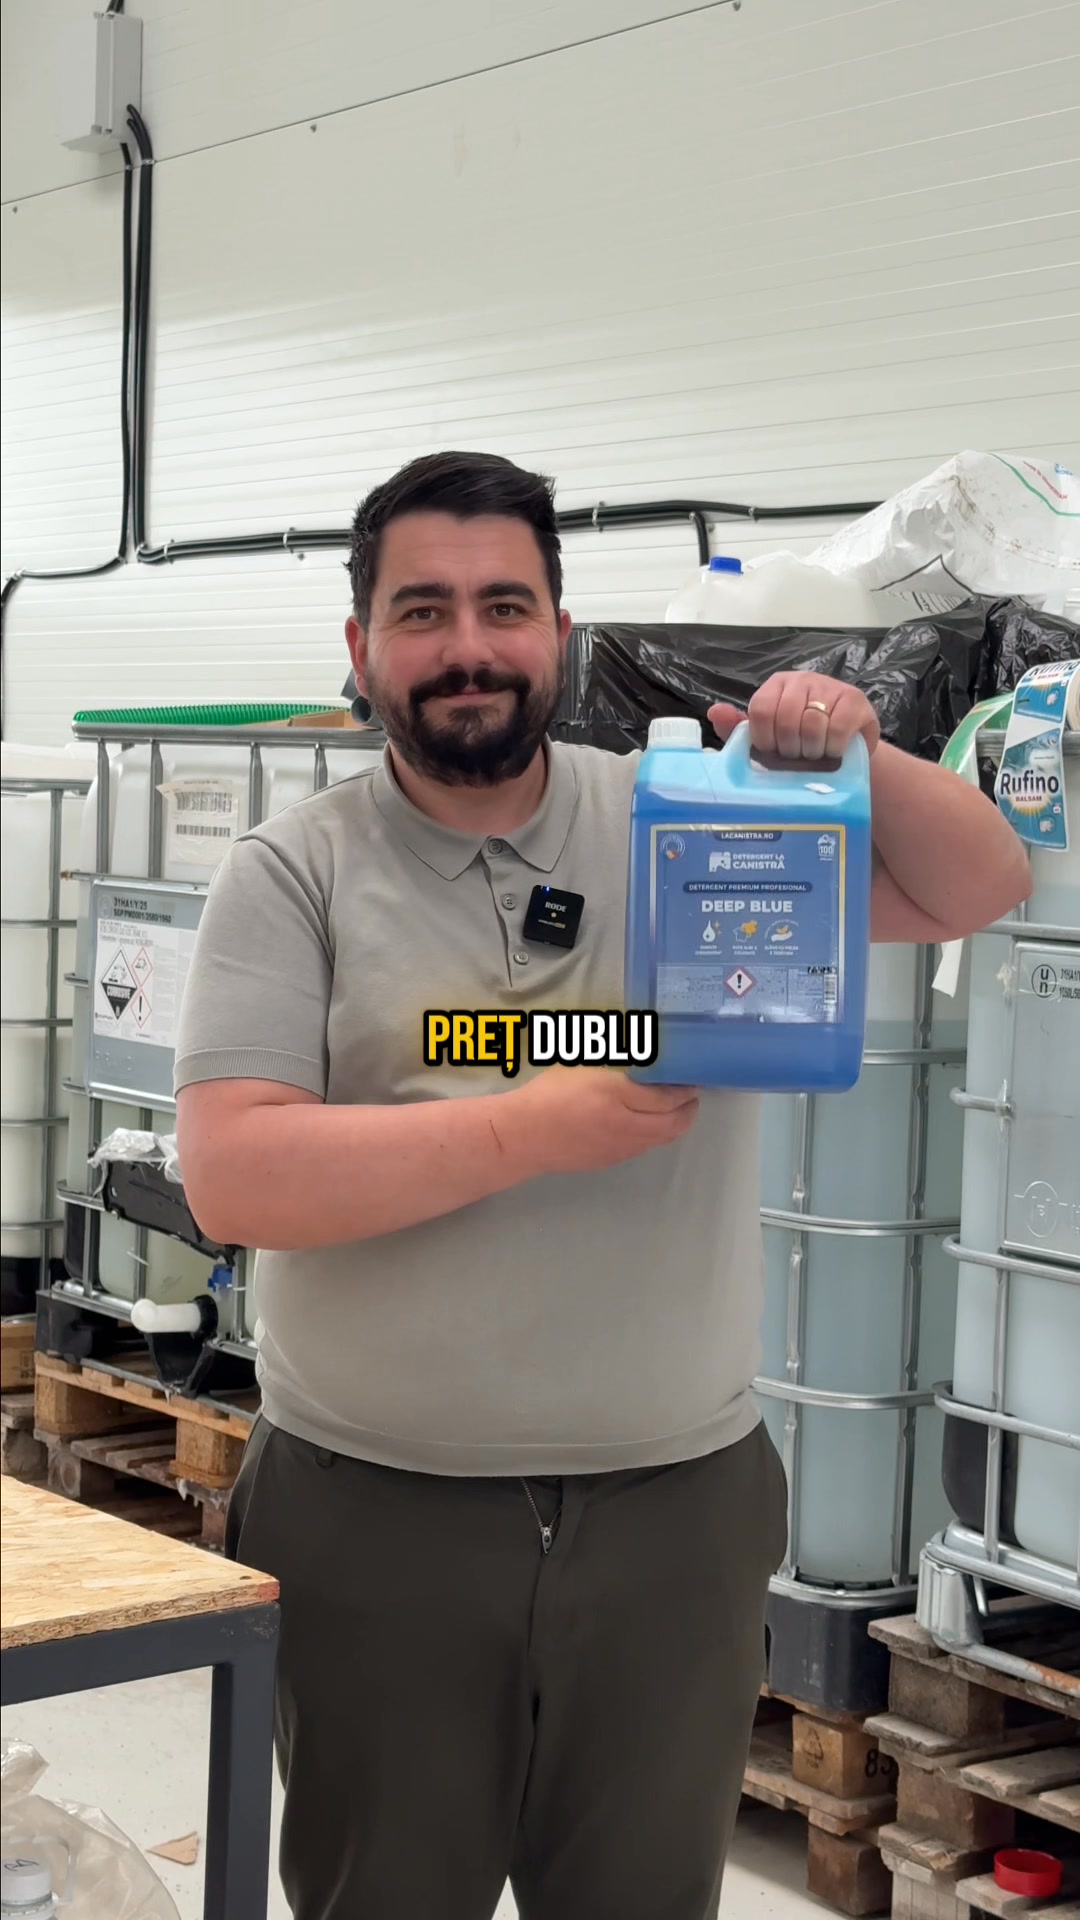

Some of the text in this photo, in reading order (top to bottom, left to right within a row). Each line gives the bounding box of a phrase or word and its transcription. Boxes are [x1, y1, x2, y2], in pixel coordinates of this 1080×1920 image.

[1000, 770, 1060, 795] Rufino
[820, 846, 833, 854] 100
[701, 900, 793, 912] DEEP BLUE
[106, 985, 132, 1000] CORROSIVE
